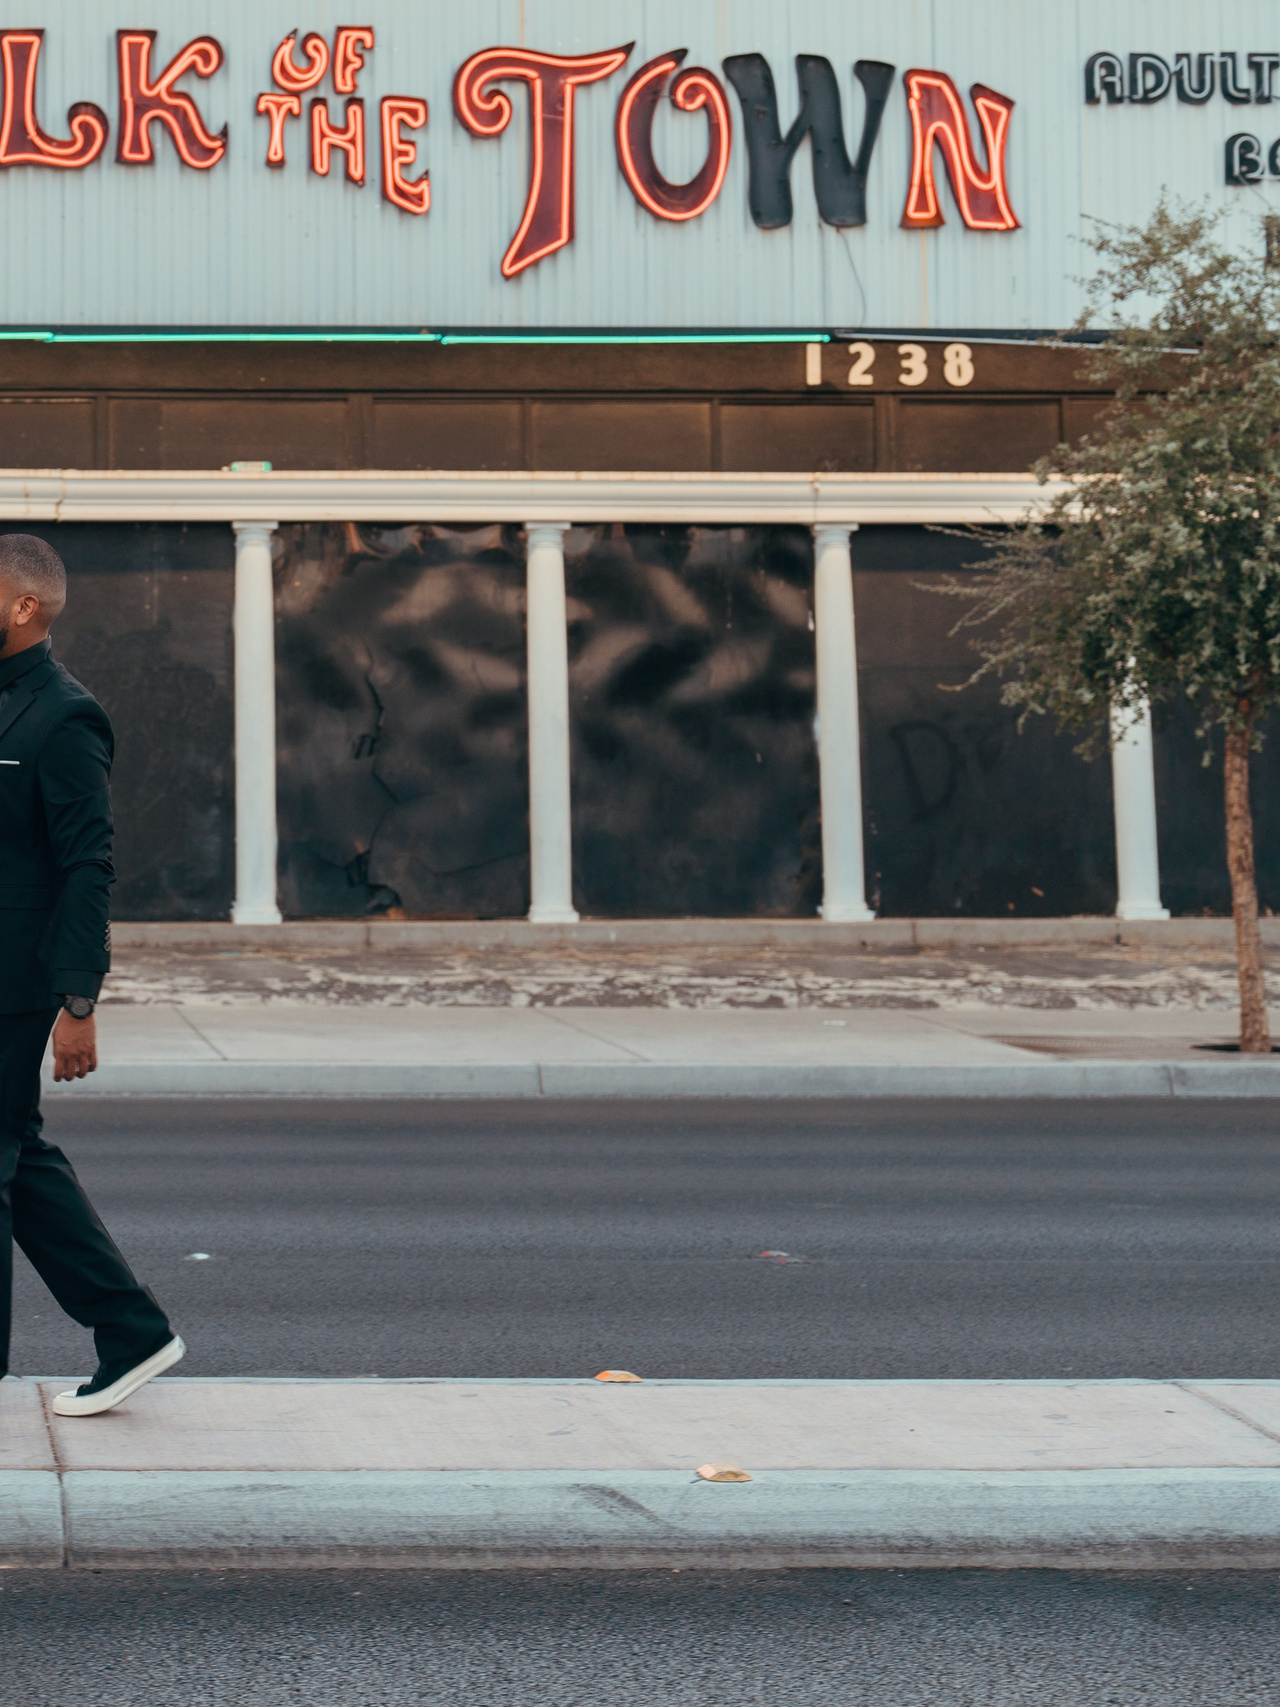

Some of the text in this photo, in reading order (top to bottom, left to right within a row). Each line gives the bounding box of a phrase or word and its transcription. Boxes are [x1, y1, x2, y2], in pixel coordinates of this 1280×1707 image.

[270, 26, 373, 95] OF
[1084, 52, 1280, 105] ADULT
[257, 93, 430, 216] THE
[453, 41, 1020, 279] TOWN
[806, 342, 975, 386] 1238
